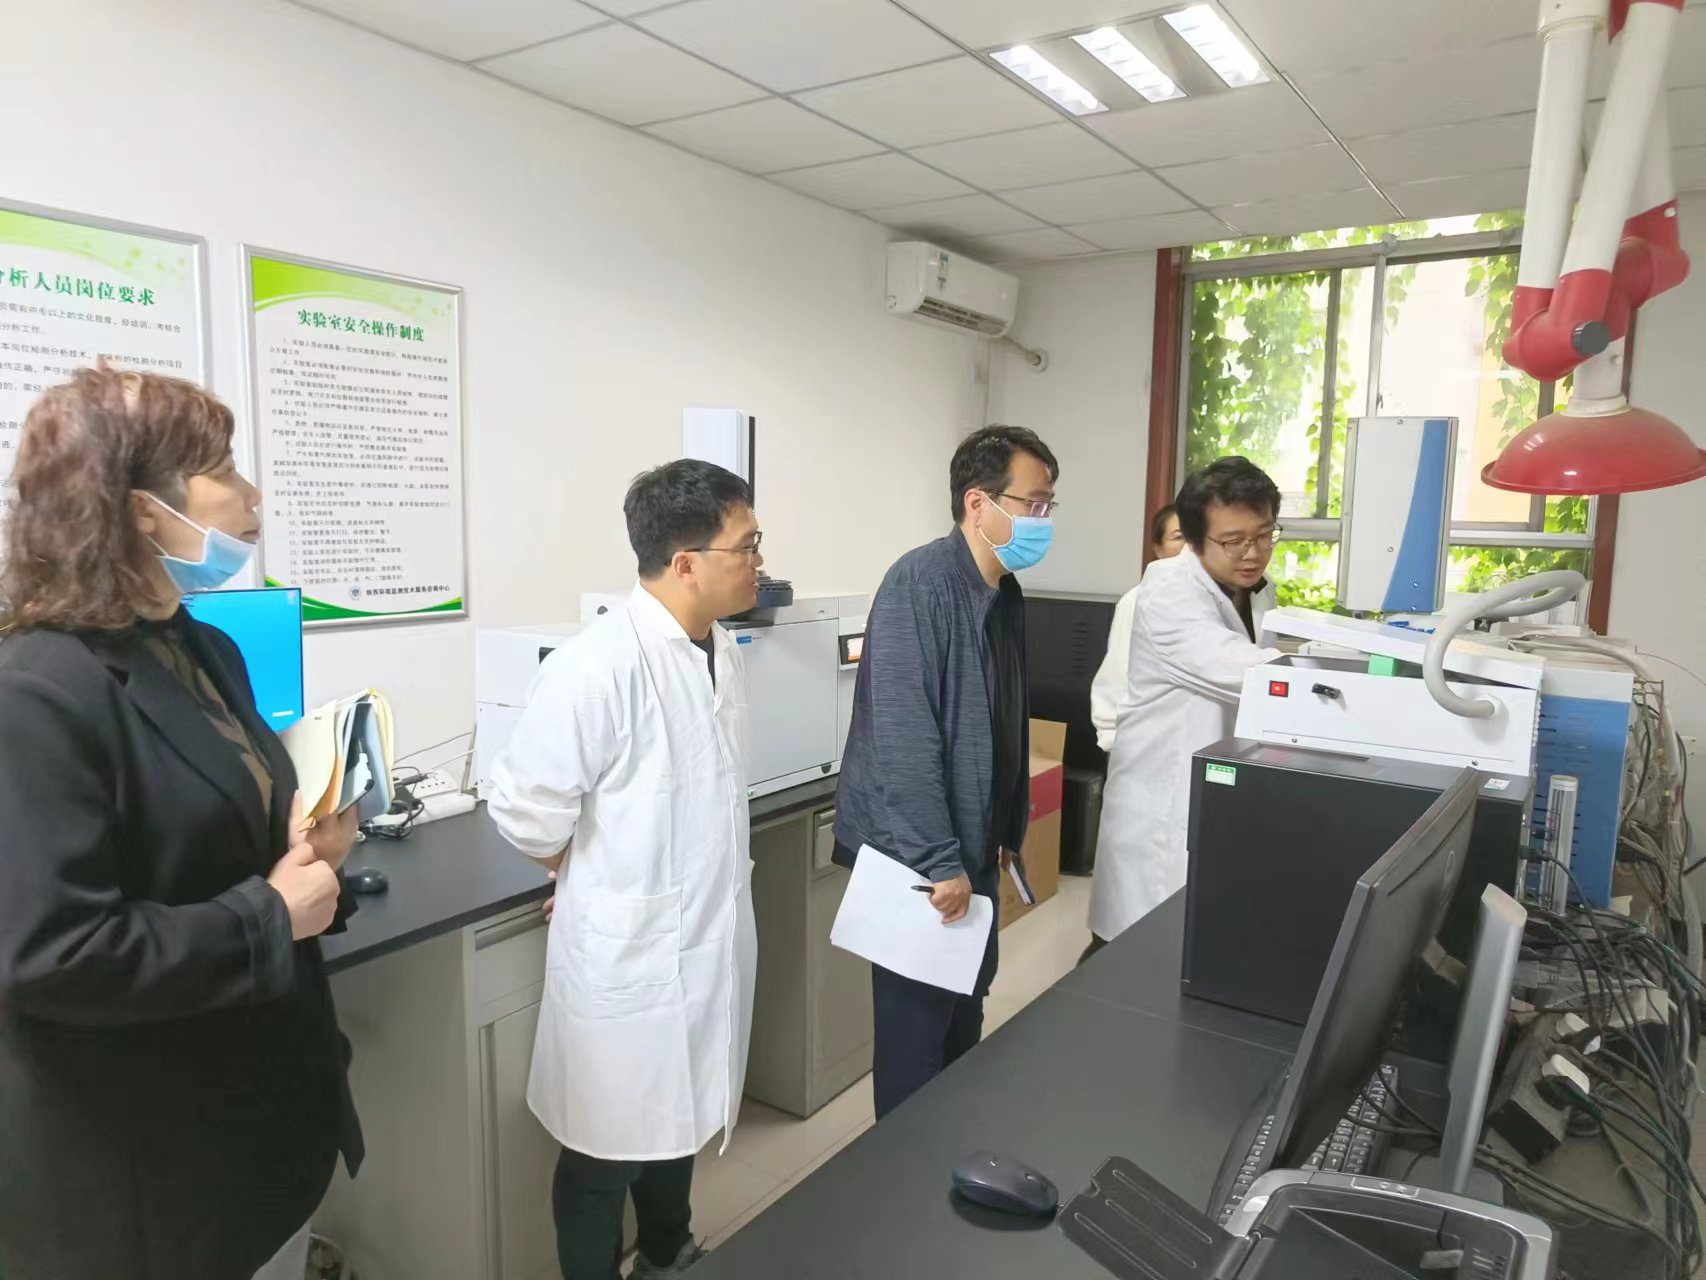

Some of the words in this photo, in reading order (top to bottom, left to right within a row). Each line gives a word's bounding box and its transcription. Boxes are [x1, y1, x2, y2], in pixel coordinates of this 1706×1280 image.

[297, 308, 425, 342] 实验室安全操作制度
